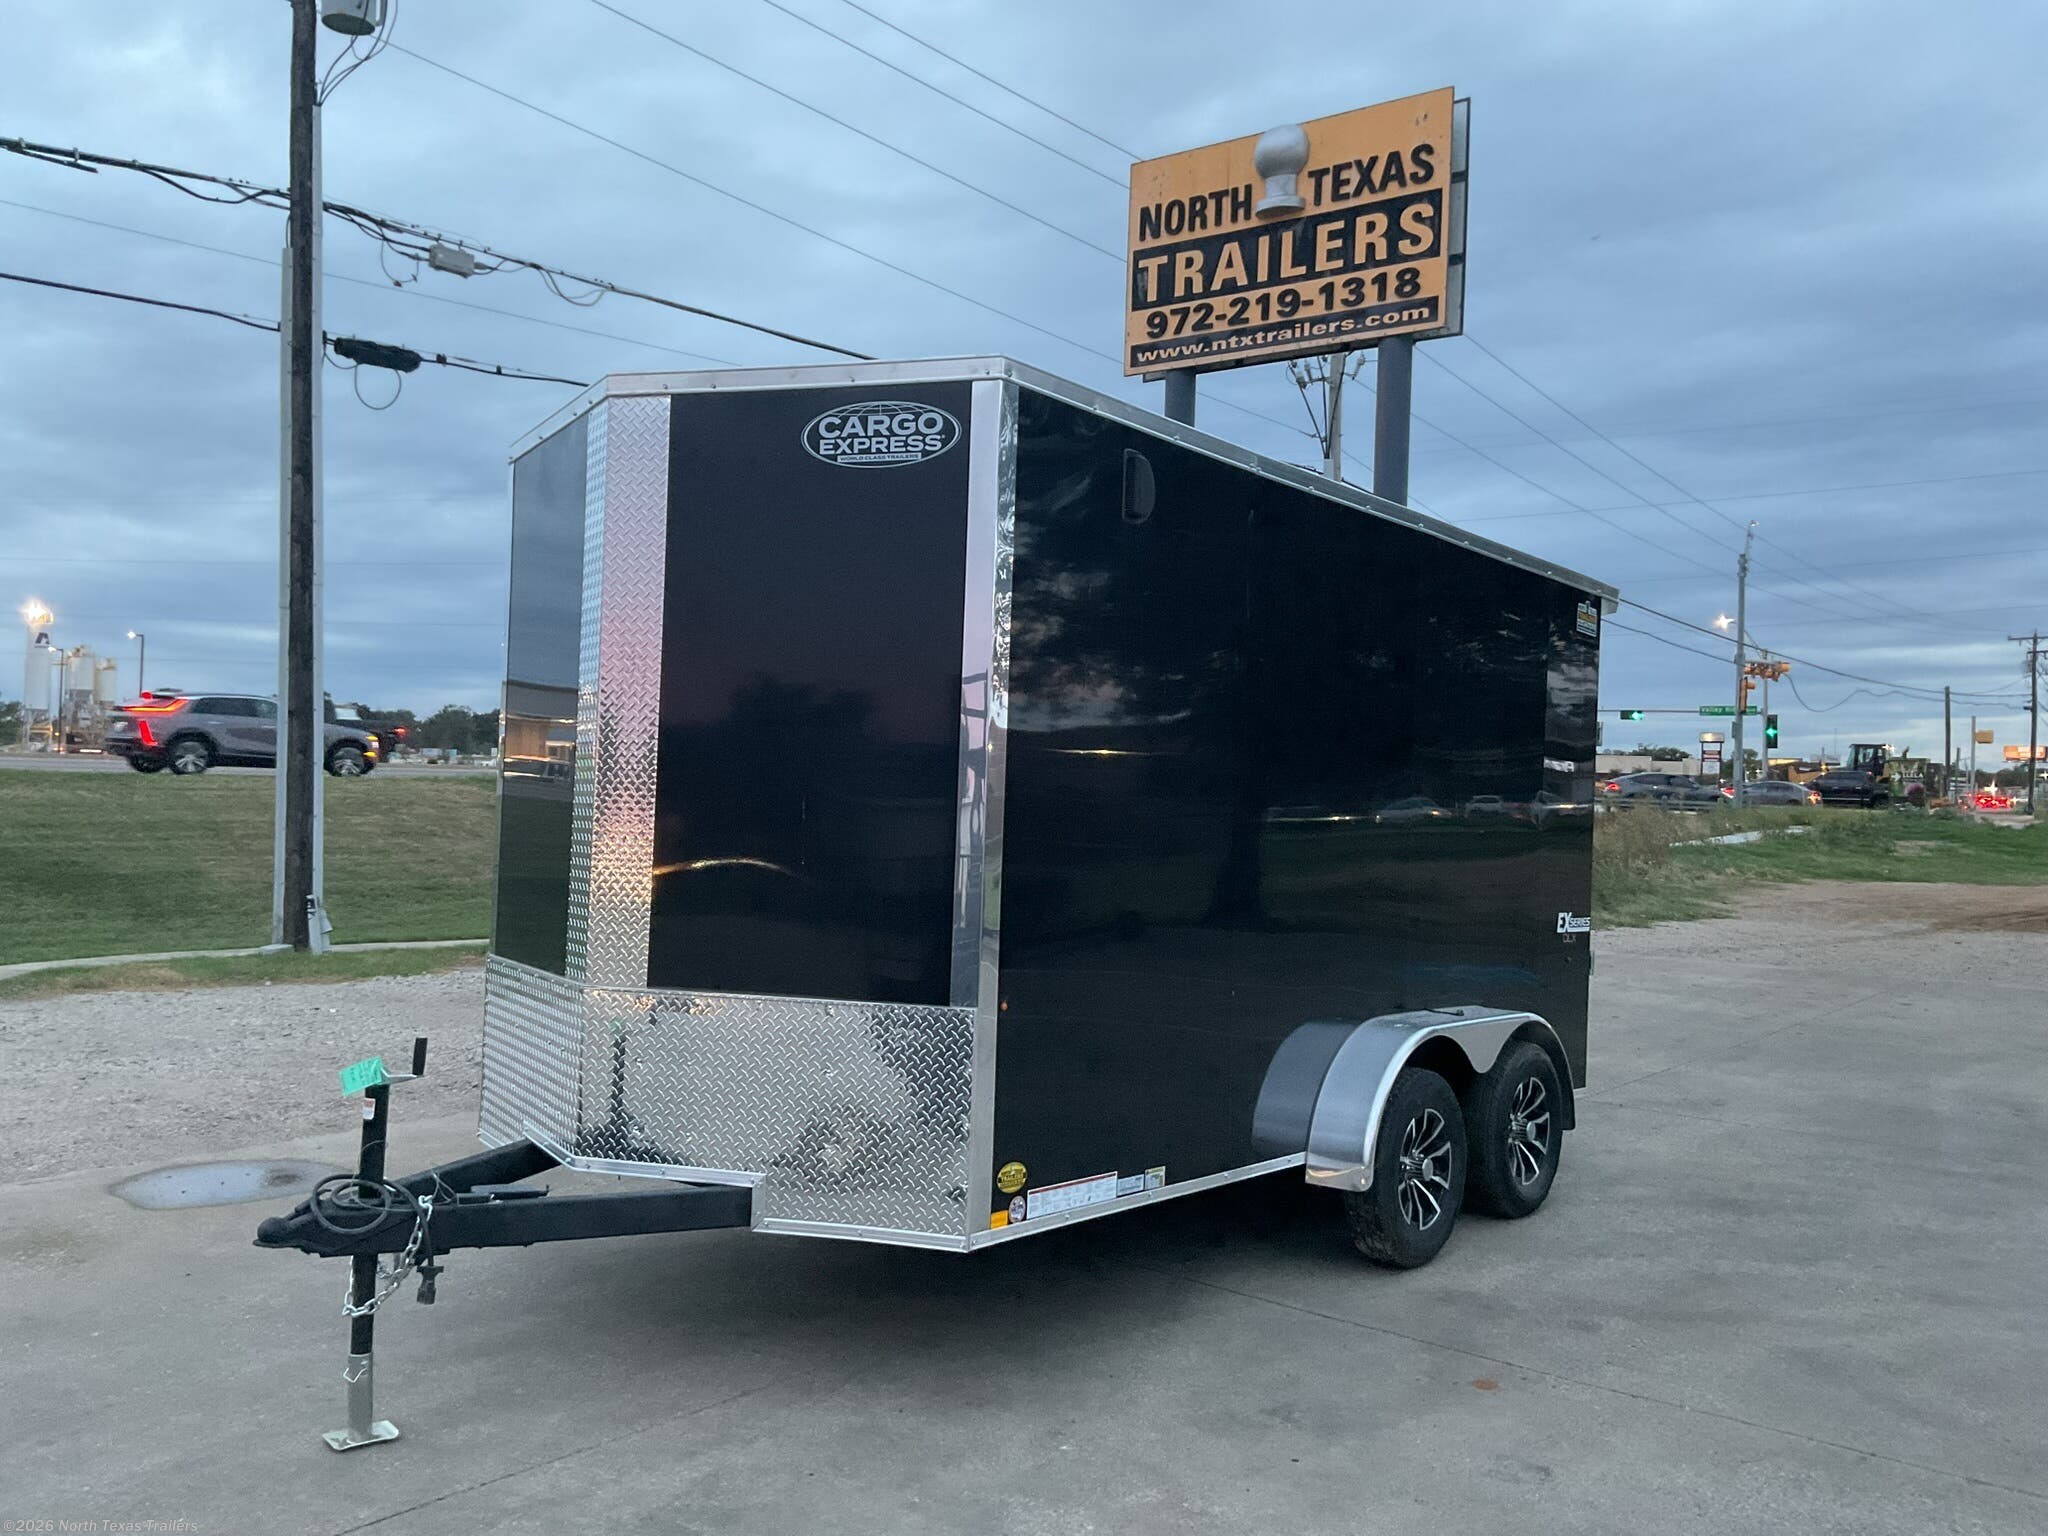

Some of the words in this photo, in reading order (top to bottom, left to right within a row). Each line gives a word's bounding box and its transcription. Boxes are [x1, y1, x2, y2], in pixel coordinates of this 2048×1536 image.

[1139, 184, 1252, 241] NORTH
[1308, 143, 1434, 206] TEXAS
[1138, 203, 1435, 302] TRAILERS
[1137, 306, 1430, 363] www.ntxtrailers.com
[1146, 267, 1421, 339] 972-219-1318
[818, 412, 944, 439] CARGO
[819, 434, 942, 455] EXPRESS
